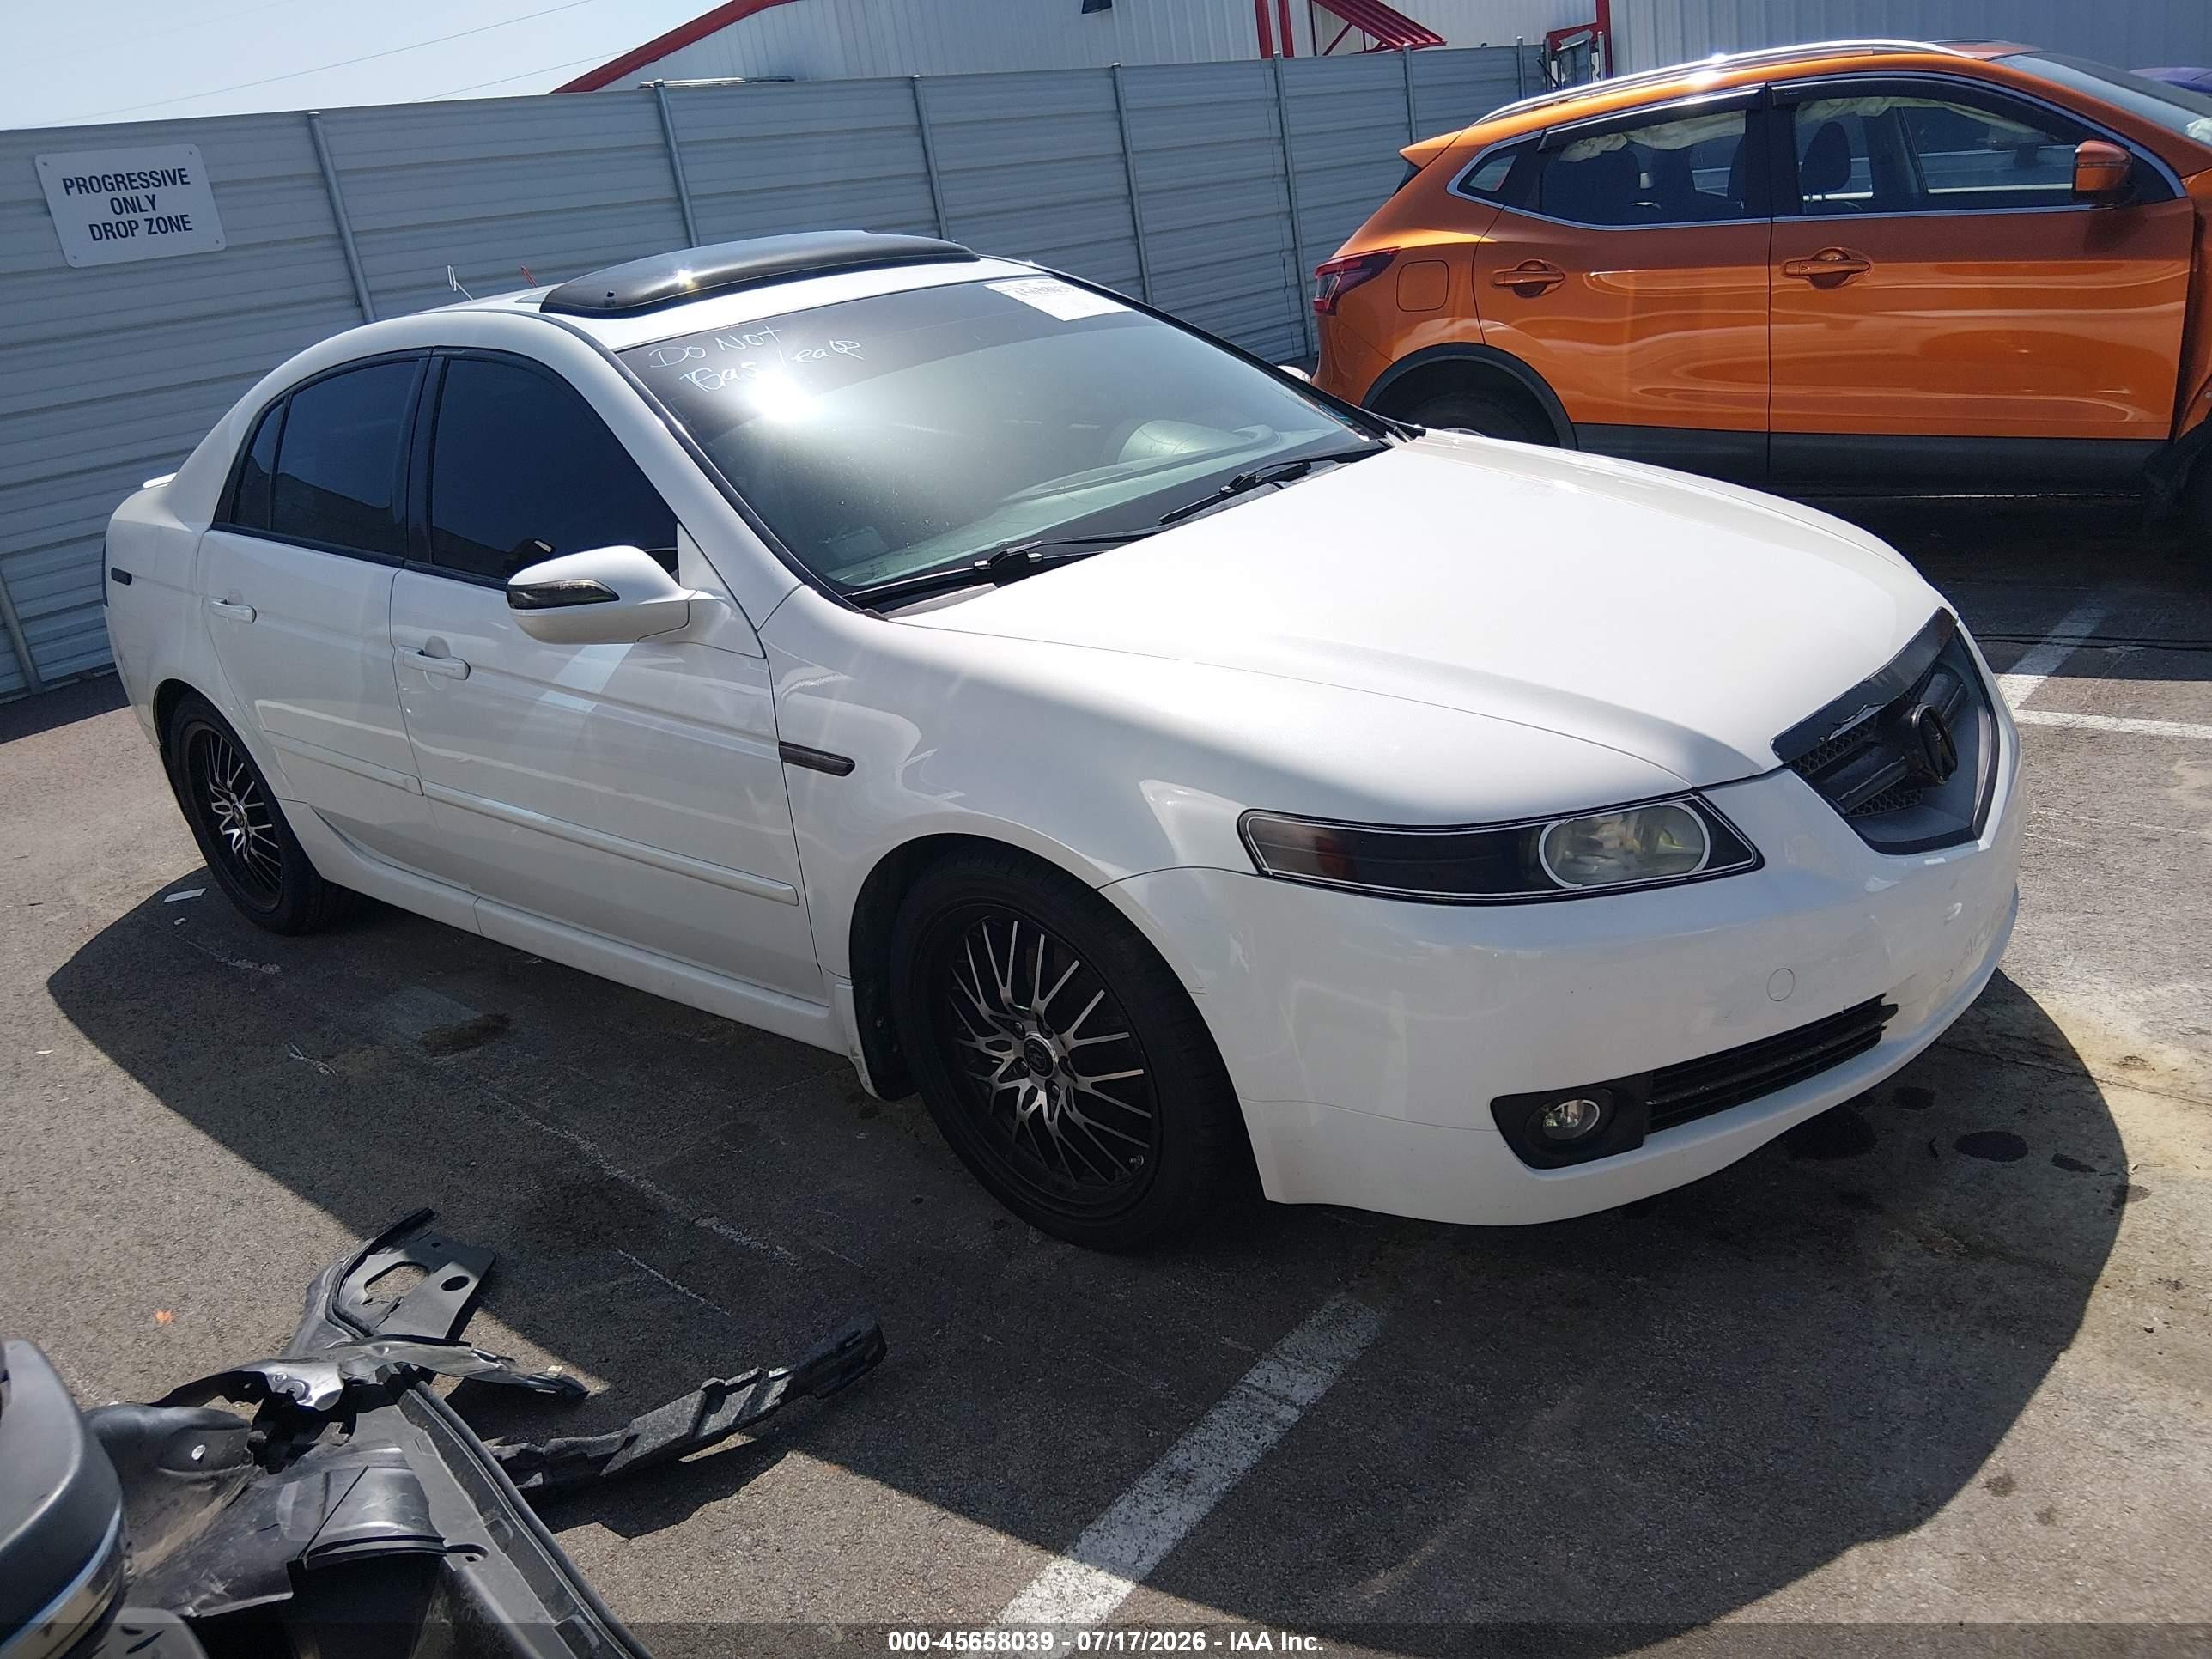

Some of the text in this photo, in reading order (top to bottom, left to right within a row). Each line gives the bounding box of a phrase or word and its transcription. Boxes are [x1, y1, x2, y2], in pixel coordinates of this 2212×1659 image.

[62, 167, 191, 196] PROGRESSIVE
[110, 194, 156, 216] ONLY
[88, 214, 193, 241] DROP ZONE
